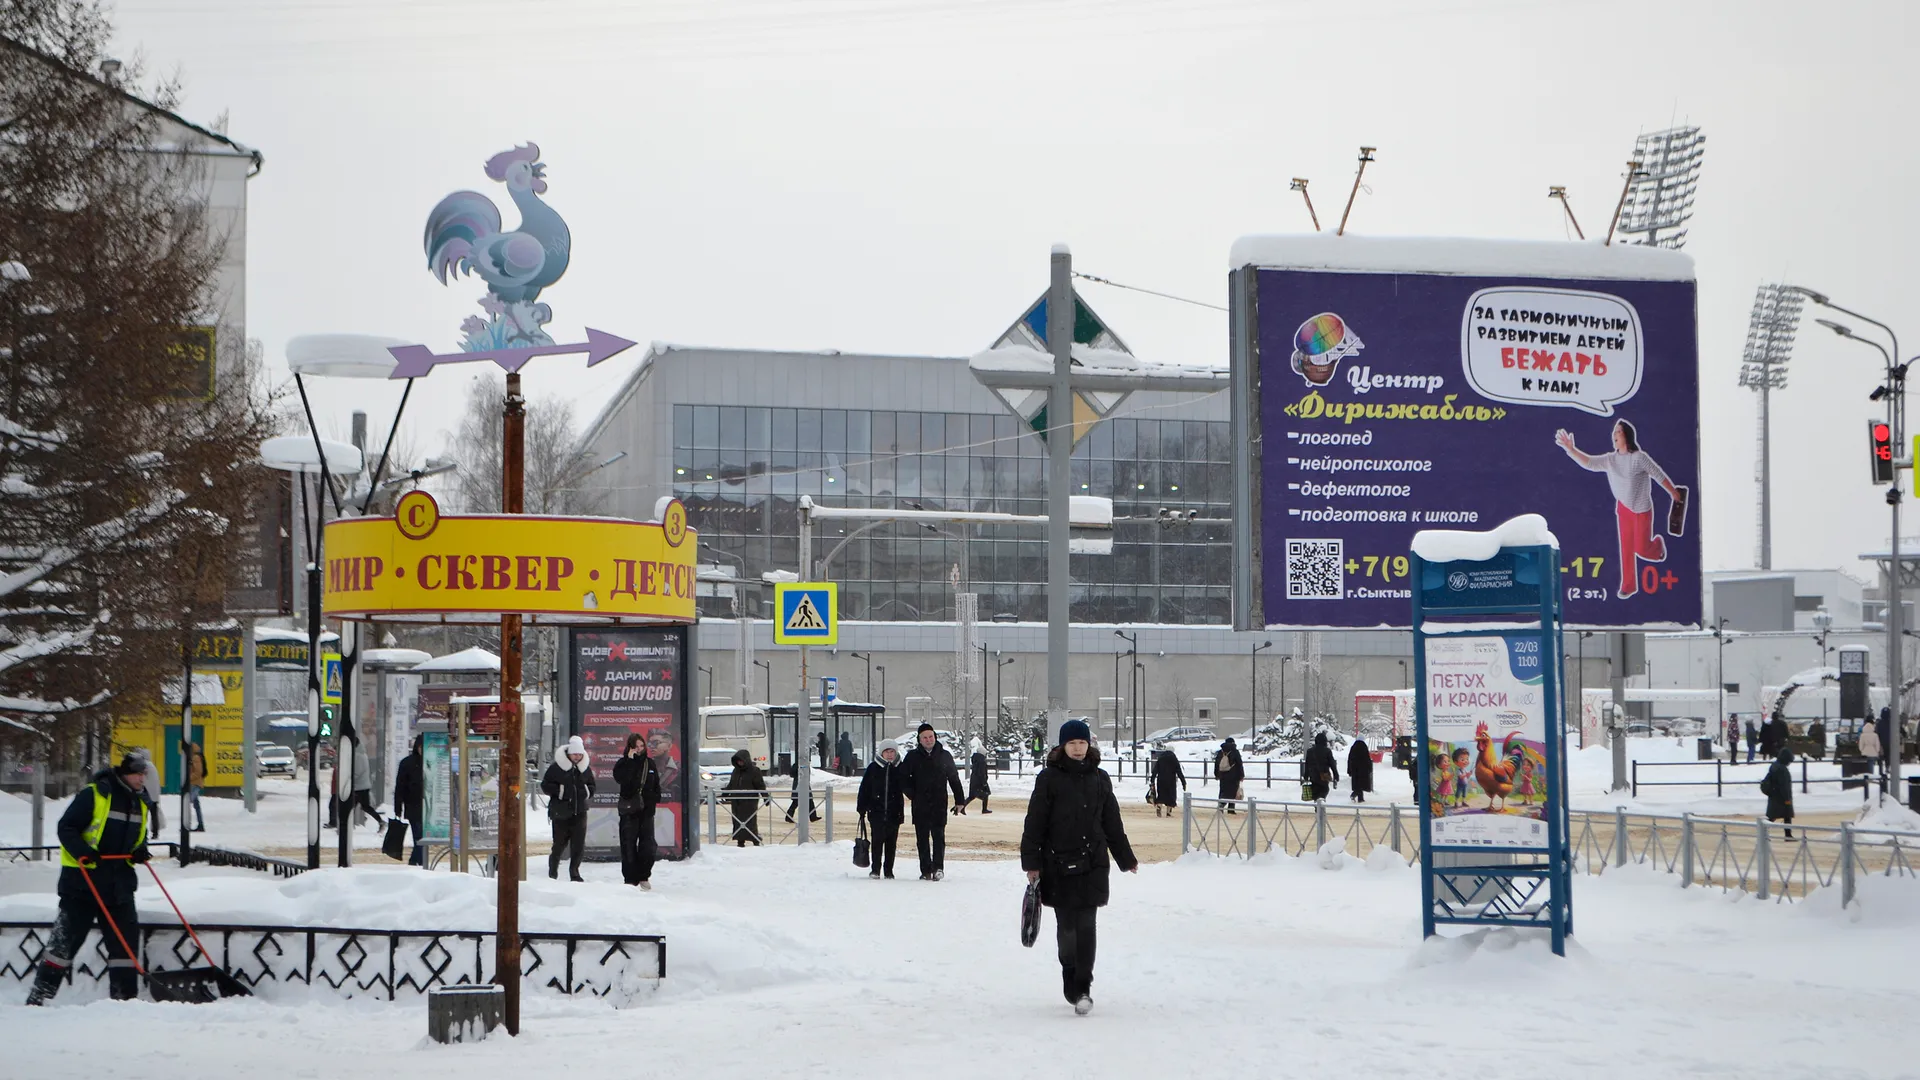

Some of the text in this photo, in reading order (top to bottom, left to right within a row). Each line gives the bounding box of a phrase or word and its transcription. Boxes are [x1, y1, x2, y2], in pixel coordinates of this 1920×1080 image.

[1475, 307, 1628, 331] ЗА ГАРМОНИЧНЫМ
[1477, 326, 1626, 351] РАЗВИТИЕМ ДЕТЕЙ
[1501, 347, 1608, 376] БЕЖАТЬ
[1347, 365, 1444, 395] Центр
[1522, 377, 1580, 394] К НАМ!
[1284, 390, 1507, 424] «Дирижабль»
[1412, 510, 1421, 522] к
[1425, 510, 1479, 523] школе
[329, 556, 384, 593] МИР
[416, 554, 574, 592] СКВЕР
[1642, 565, 1679, 595] 0+
[1469, 580, 1513, 589] ФИЛАРМОНИЯ
[1514, 641, 1538, 653] 22/03
[1518, 656, 1538, 667] 11:00
[605, 671, 652, 682] ДАРИМ
[1433, 673, 1486, 688] ПЕТУХ
[584, 685, 673, 701] 500 БОНУСОВ
[1433, 692, 1508, 707] И КРАСКИ
